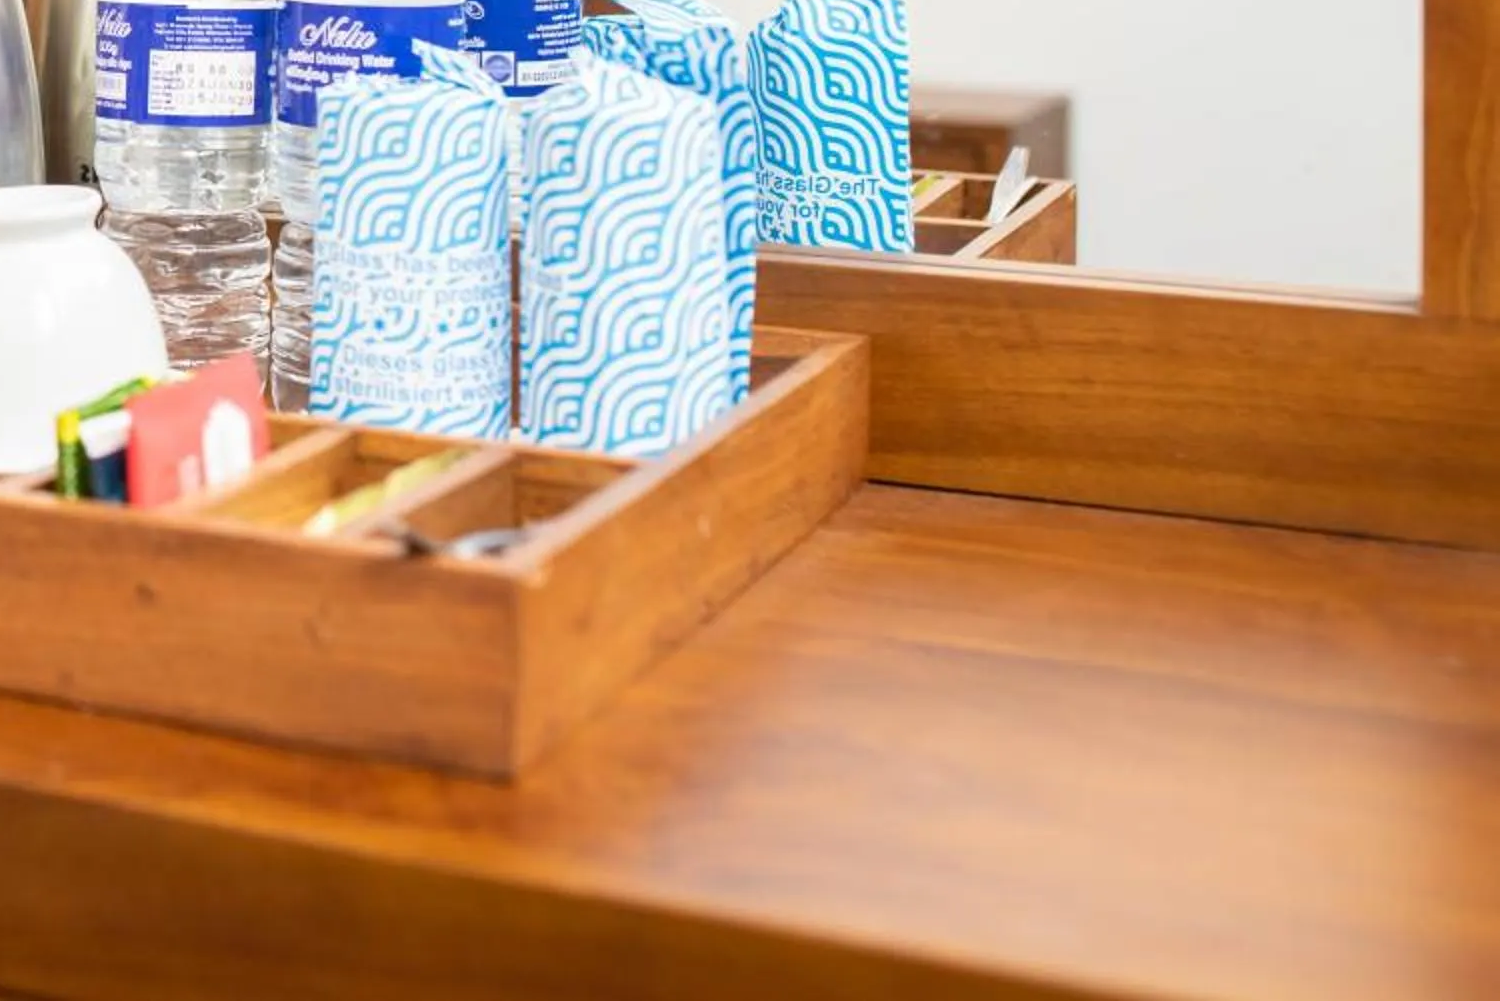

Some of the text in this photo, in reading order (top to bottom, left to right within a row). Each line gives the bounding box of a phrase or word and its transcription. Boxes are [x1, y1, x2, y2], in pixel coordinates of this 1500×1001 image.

[315, 50, 360, 71] Drinking
[361, 54, 396, 68] Water
[369, 282, 424, 305] your
[343, 343, 423, 372] Dieses
[334, 376, 452, 403] sterilisiert
